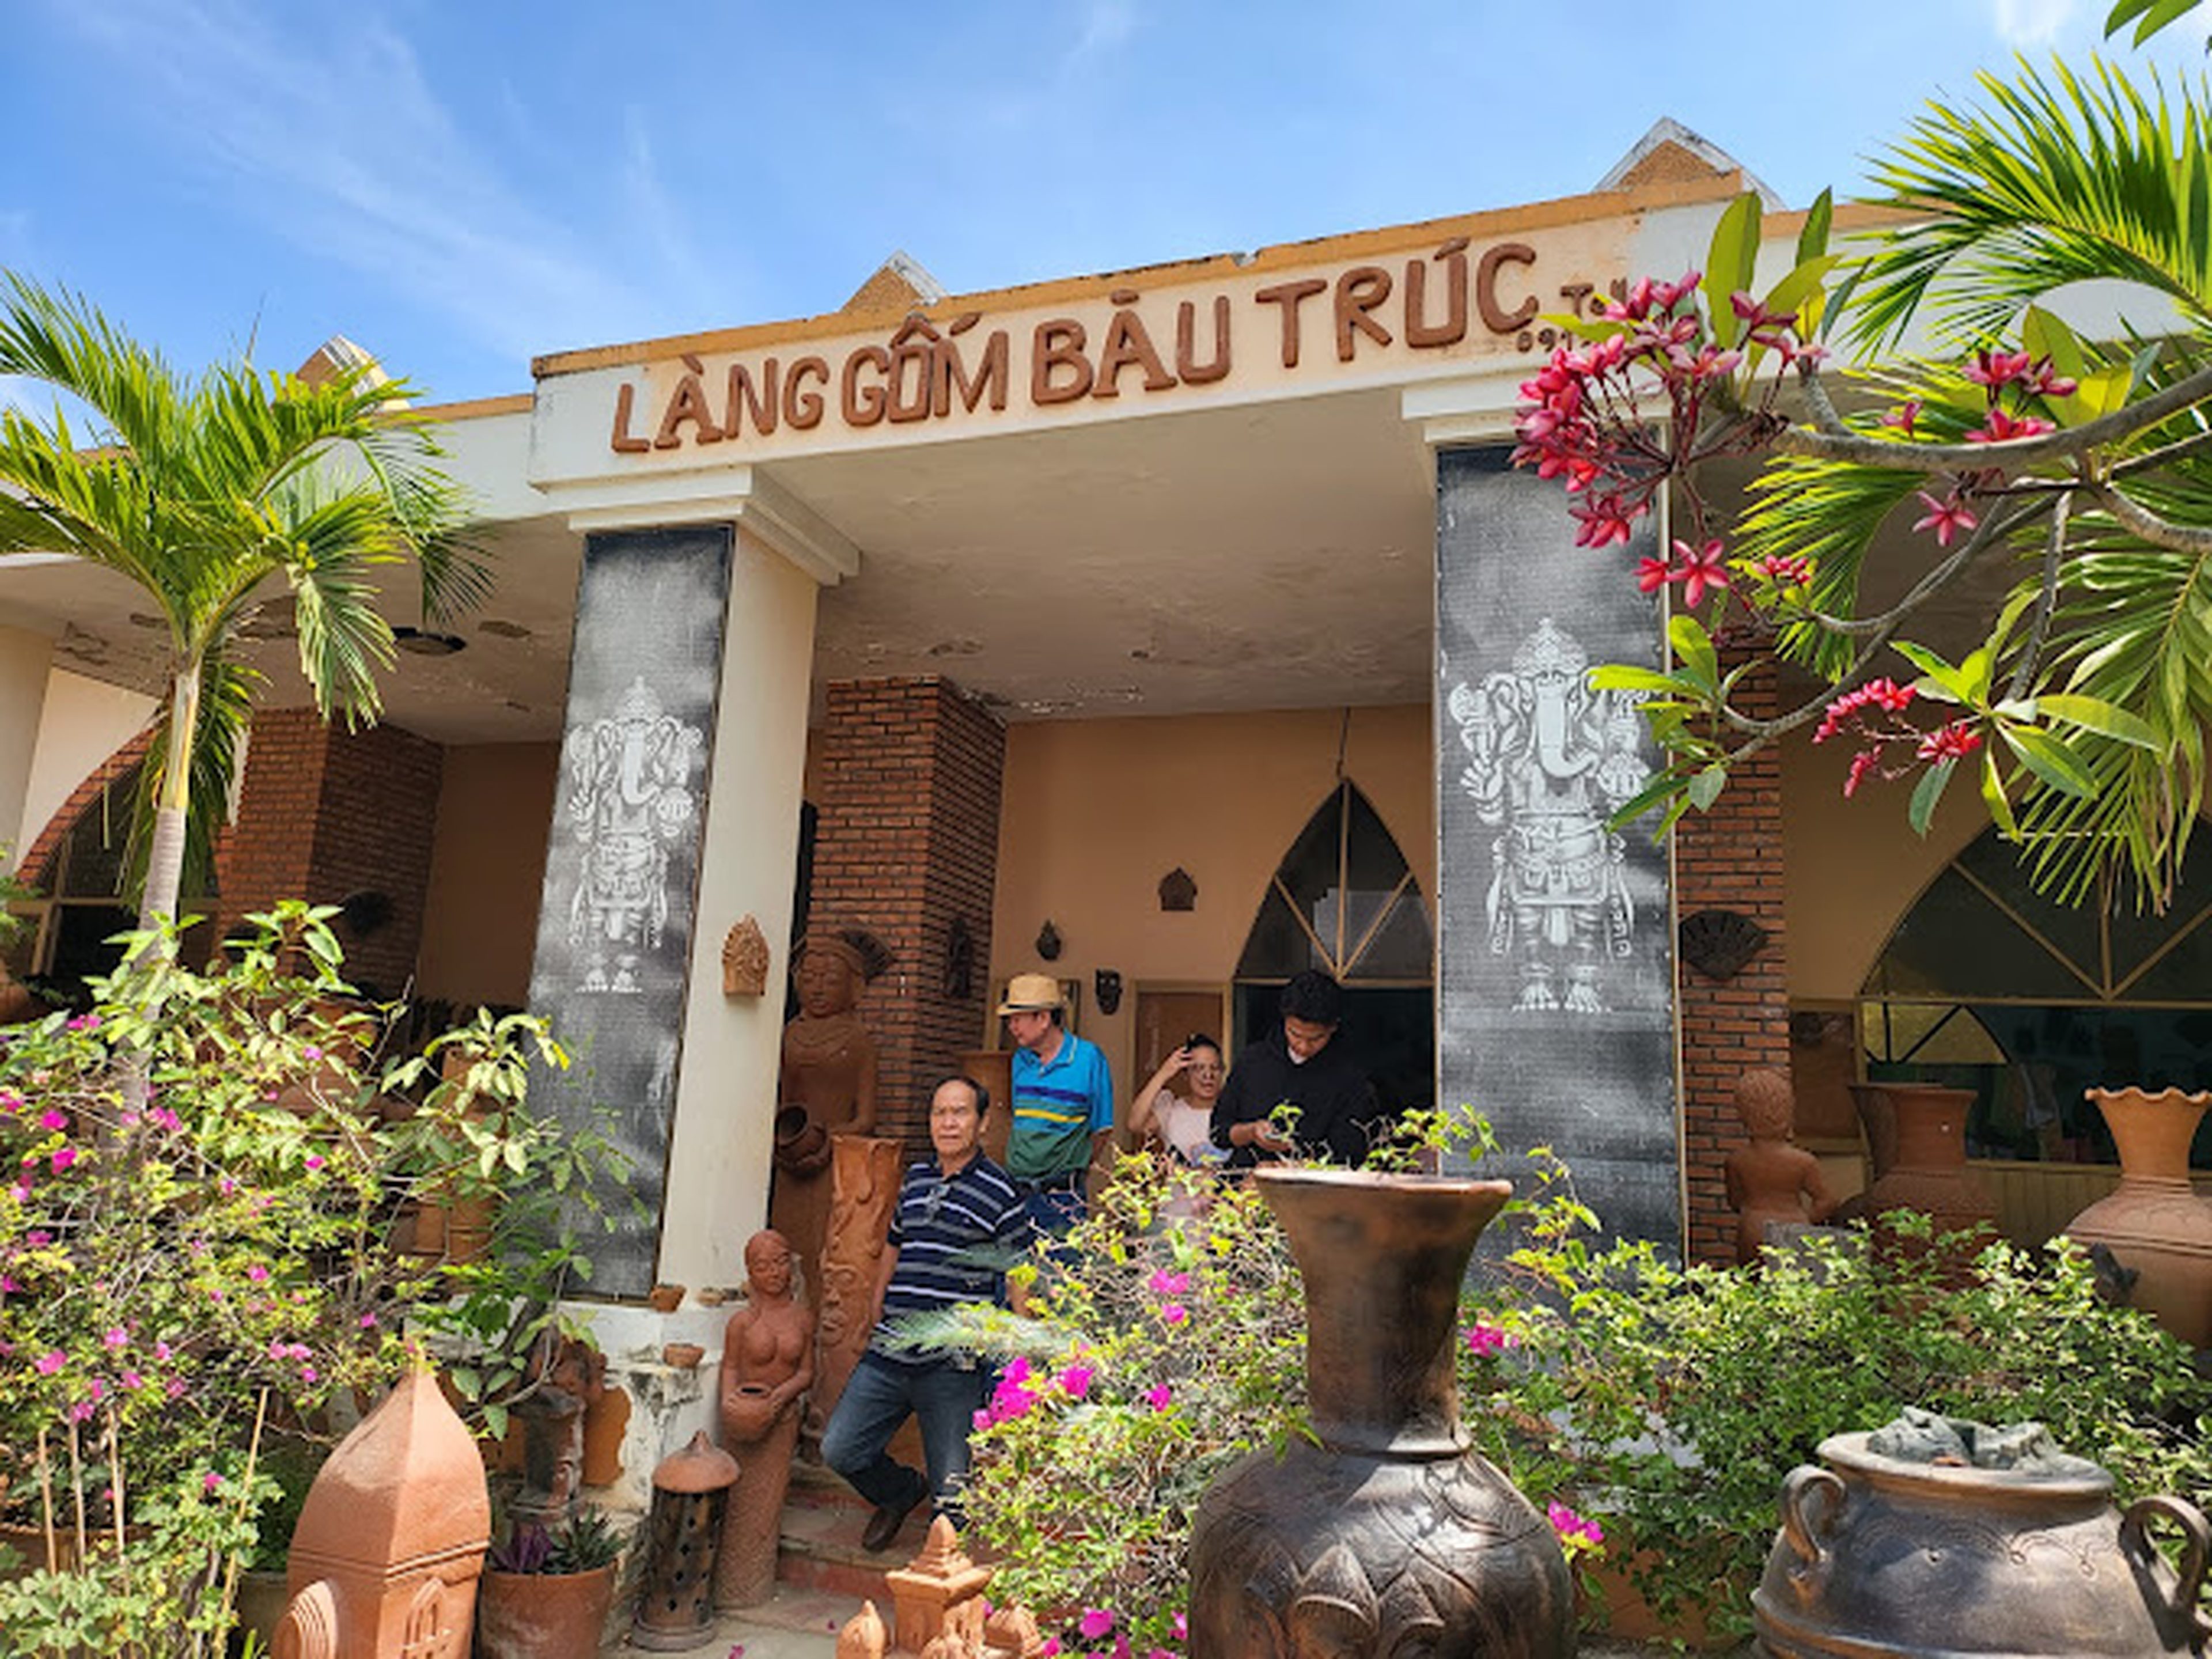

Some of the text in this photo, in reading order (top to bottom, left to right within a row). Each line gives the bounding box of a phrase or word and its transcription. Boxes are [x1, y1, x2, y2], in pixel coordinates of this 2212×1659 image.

[611, 354, 831, 453] LÀNG
[841, 311, 1009, 427] GỐM
[1255, 237, 1539, 369] TRÚC
